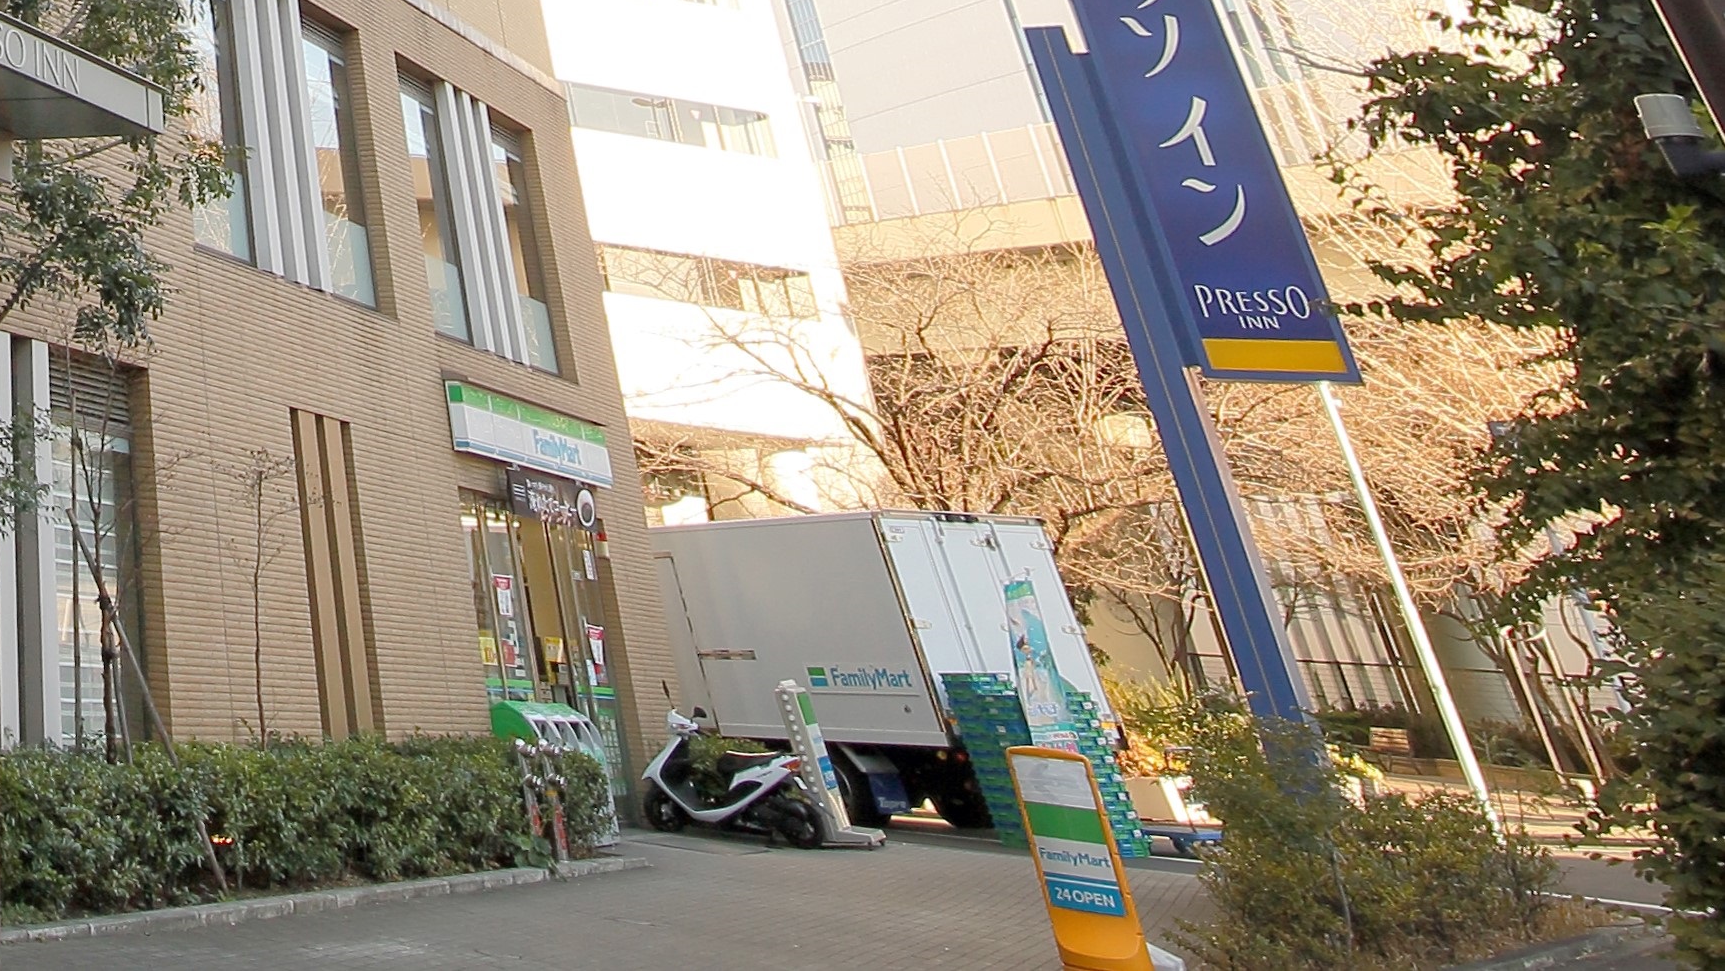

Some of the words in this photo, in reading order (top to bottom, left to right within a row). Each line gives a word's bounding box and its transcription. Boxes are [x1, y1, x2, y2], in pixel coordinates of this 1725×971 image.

[34, 37, 80, 95] INN
[1193, 284, 1311, 320] PRESSO
[1238, 315, 1281, 330] INN
[533, 428, 583, 466] FamilyMart
[829, 666, 913, 690] FamilyMart
[1039, 848, 1110, 867] FamilyMart
